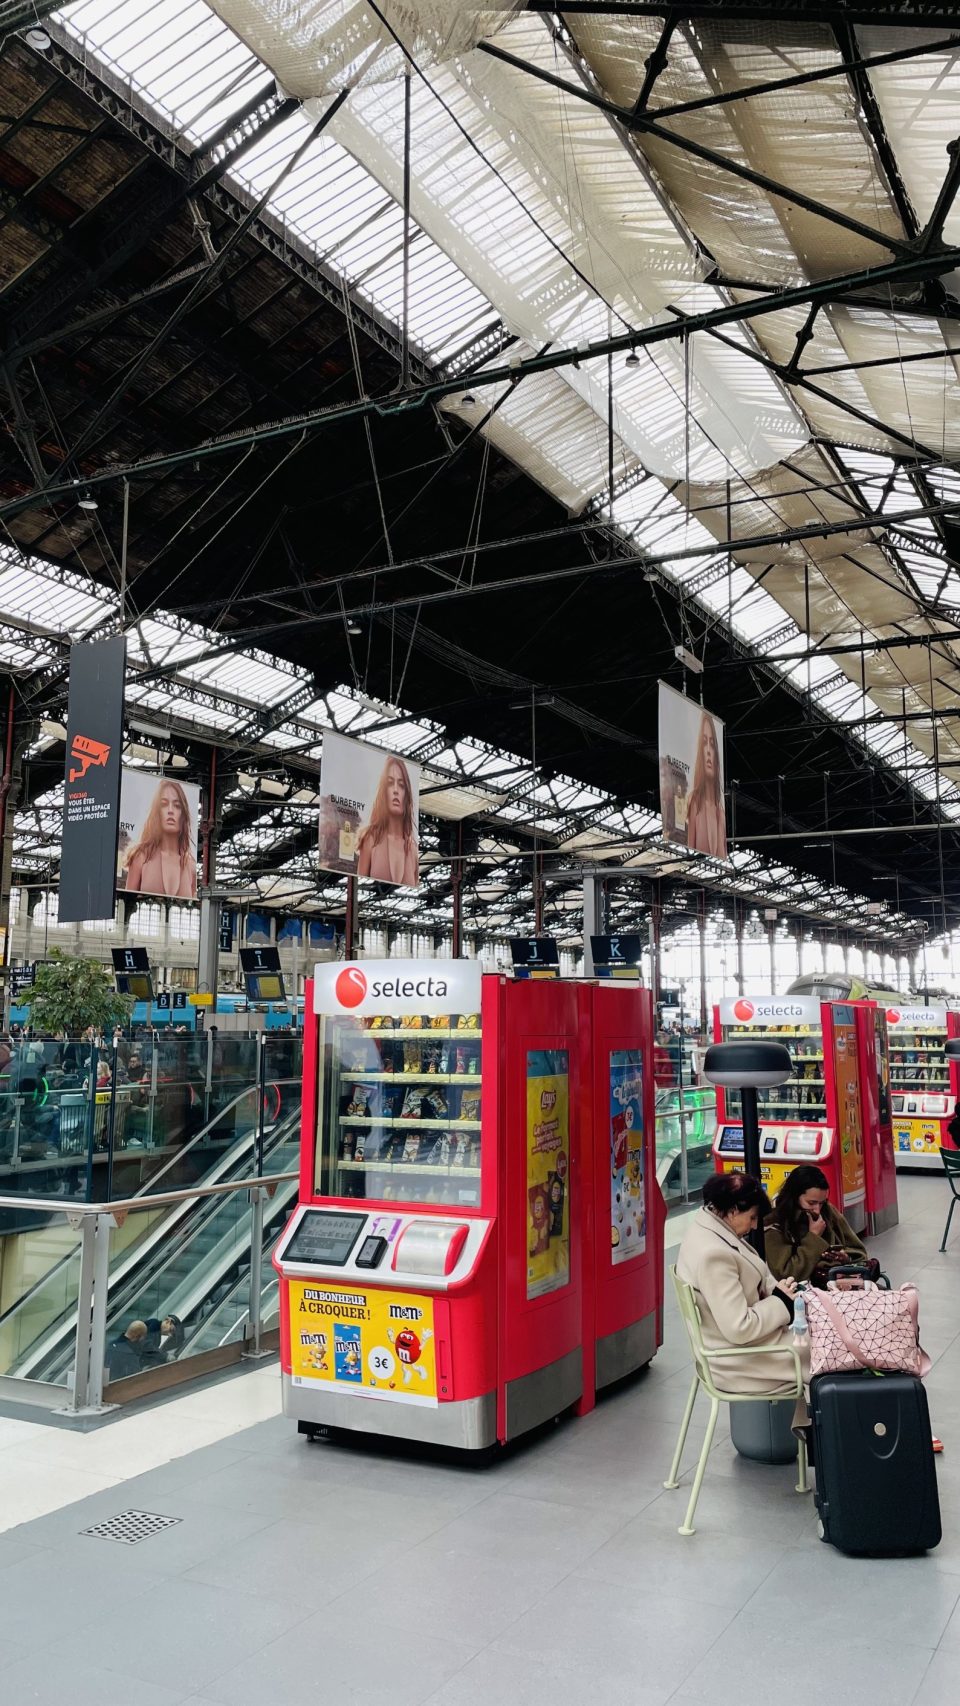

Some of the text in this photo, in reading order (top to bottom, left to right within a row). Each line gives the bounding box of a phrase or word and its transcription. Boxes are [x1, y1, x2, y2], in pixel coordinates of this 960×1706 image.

[83, 797, 95, 805] ÊTES
[330, 794, 365, 811] BURBERRY
[67, 806, 82, 814] DANS
[91, 803, 111, 812] ESPACE
[67, 813, 84, 821] VIDÉO
[222, 916, 229, 927] H
[610, 943, 622, 957] K
[124, 955, 134, 966] H
[371, 977, 447, 998] selecta
[160, 997, 167, 1006] D
[177, 997, 182, 1005] E
[757, 1003, 803, 1017] selecta
[902, 1012, 935, 1021] selecta
[304, 1289, 365, 1306] DU BONHEUR
[299, 1298, 371, 1321] À CROQUER !
[374, 1356, 388, 1370] 3€
